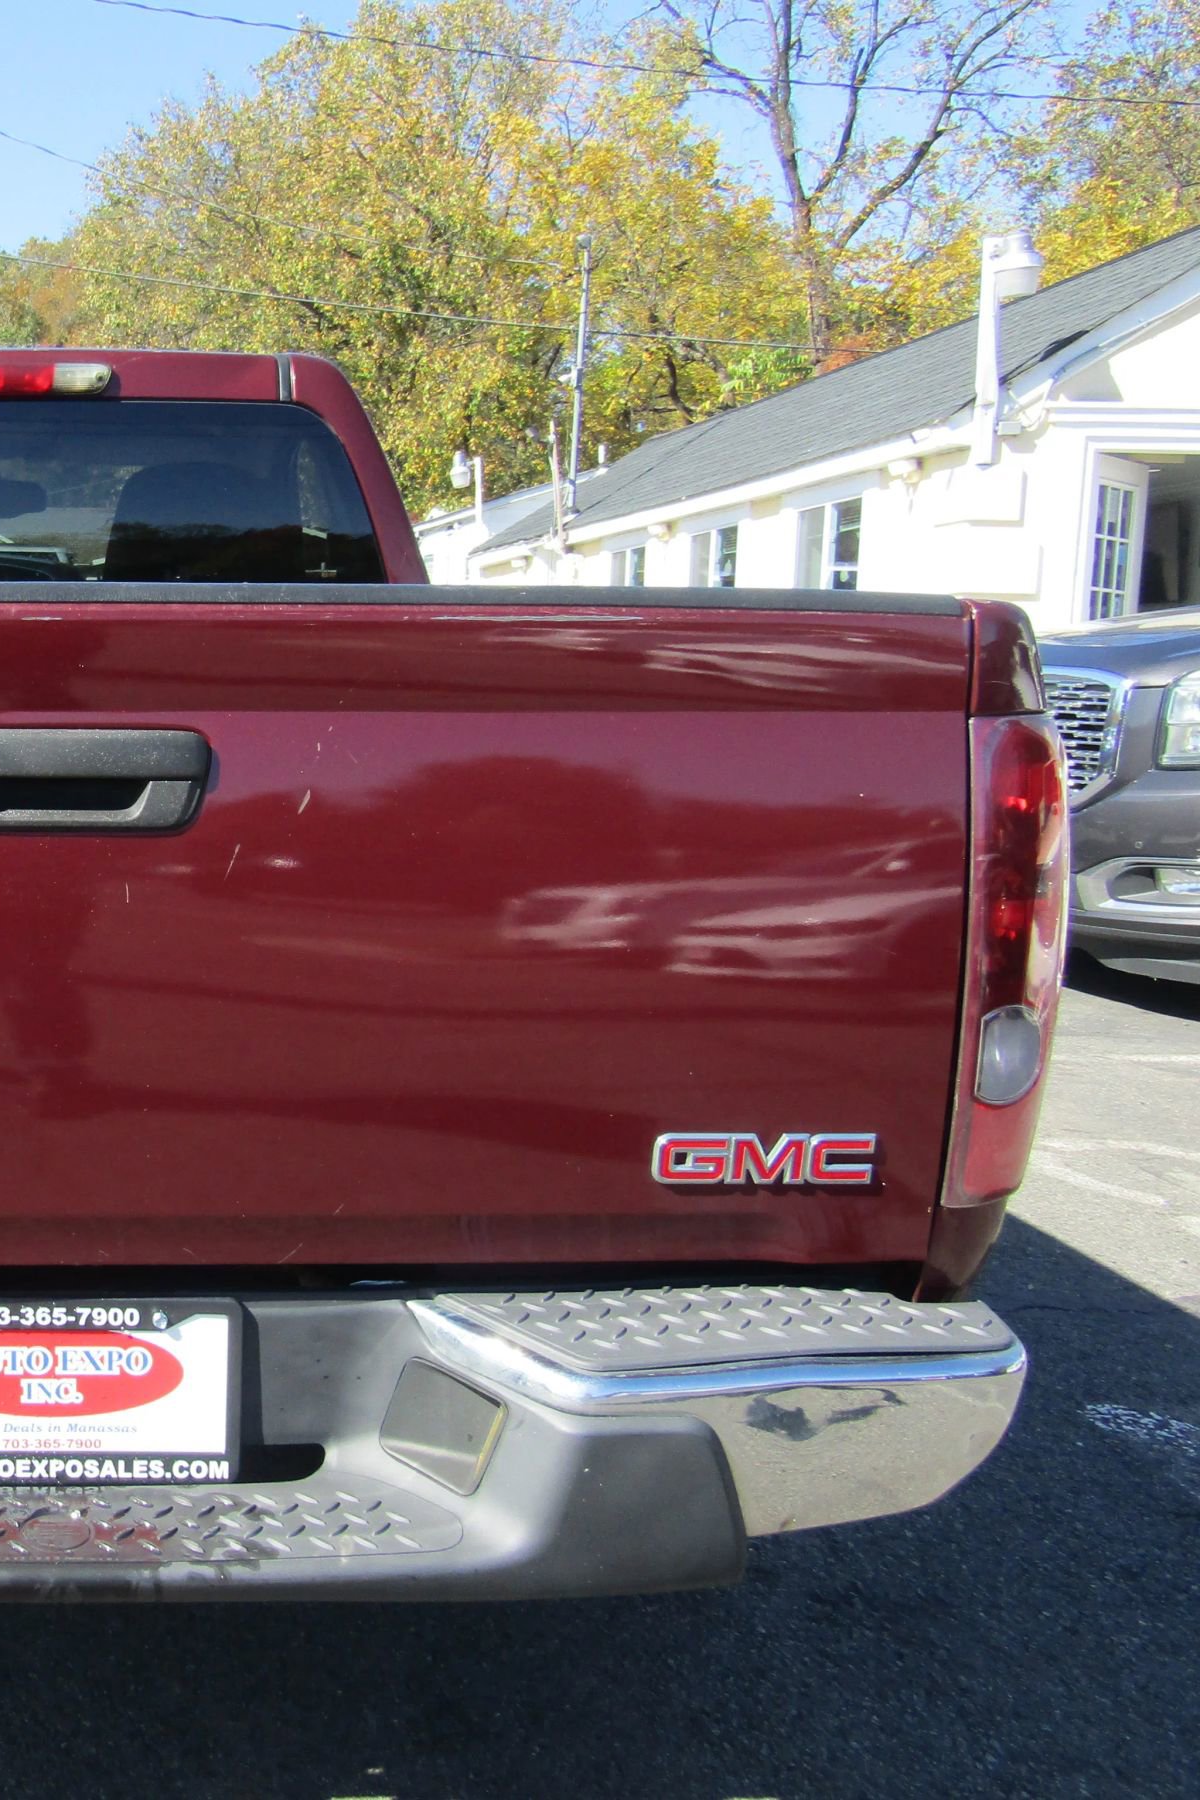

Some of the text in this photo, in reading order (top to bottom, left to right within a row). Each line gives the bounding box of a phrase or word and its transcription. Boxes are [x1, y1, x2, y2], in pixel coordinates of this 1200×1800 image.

[651, 1132, 877, 1185] GMC
[55, 1346, 153, 1376] EXPO
[20, 1378, 84, 1405] INC.
[2, 1422, 42, 1434] Deals
[48, 1422, 62, 1434] in
[66, 1422, 138, 1434] Manassas
[2, 1438, 102, 1450] 703-365-7900
